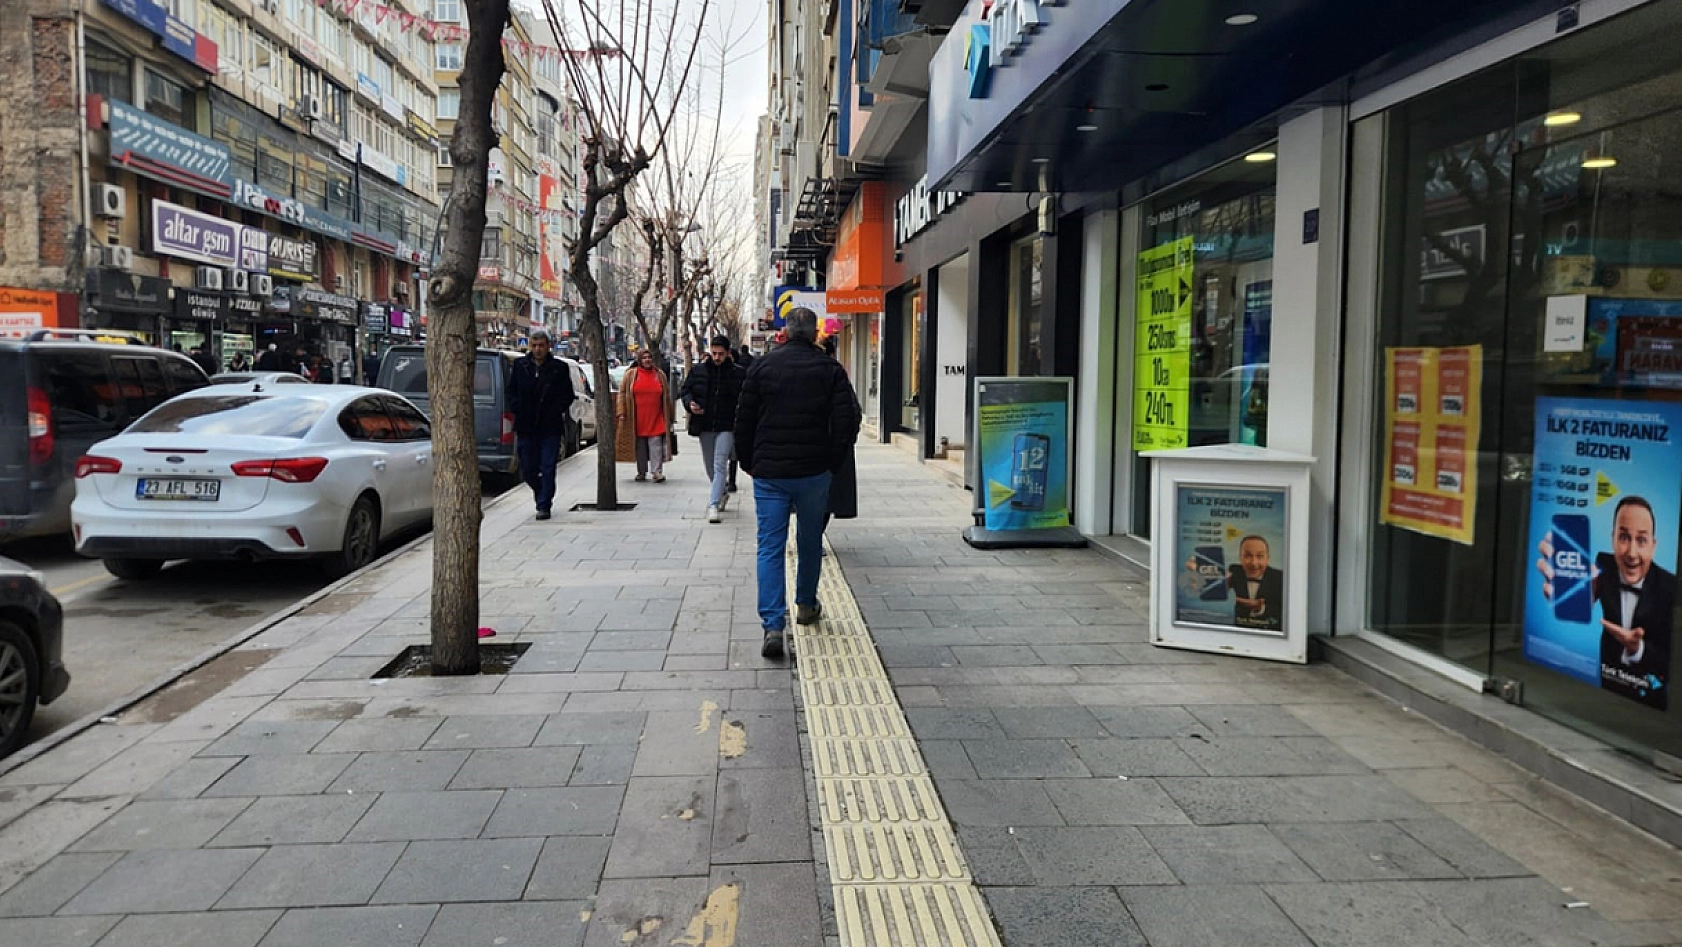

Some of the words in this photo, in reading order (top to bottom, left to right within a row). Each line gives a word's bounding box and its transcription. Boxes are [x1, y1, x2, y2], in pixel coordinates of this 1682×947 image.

[164, 212, 199, 244] altar
[201, 229, 229, 255] gsm
[1547, 414, 1567, 433] İLK
[1571, 420, 1580, 435] 2
[1583, 420, 1670, 442] FATURANIZ
[1576, 439, 1631, 462] BİZDEN
[145, 481, 160, 494] 23
[165, 481, 187, 495] AFL
[194, 482, 217, 495] 516
[1555, 550, 1587, 570] GEL
